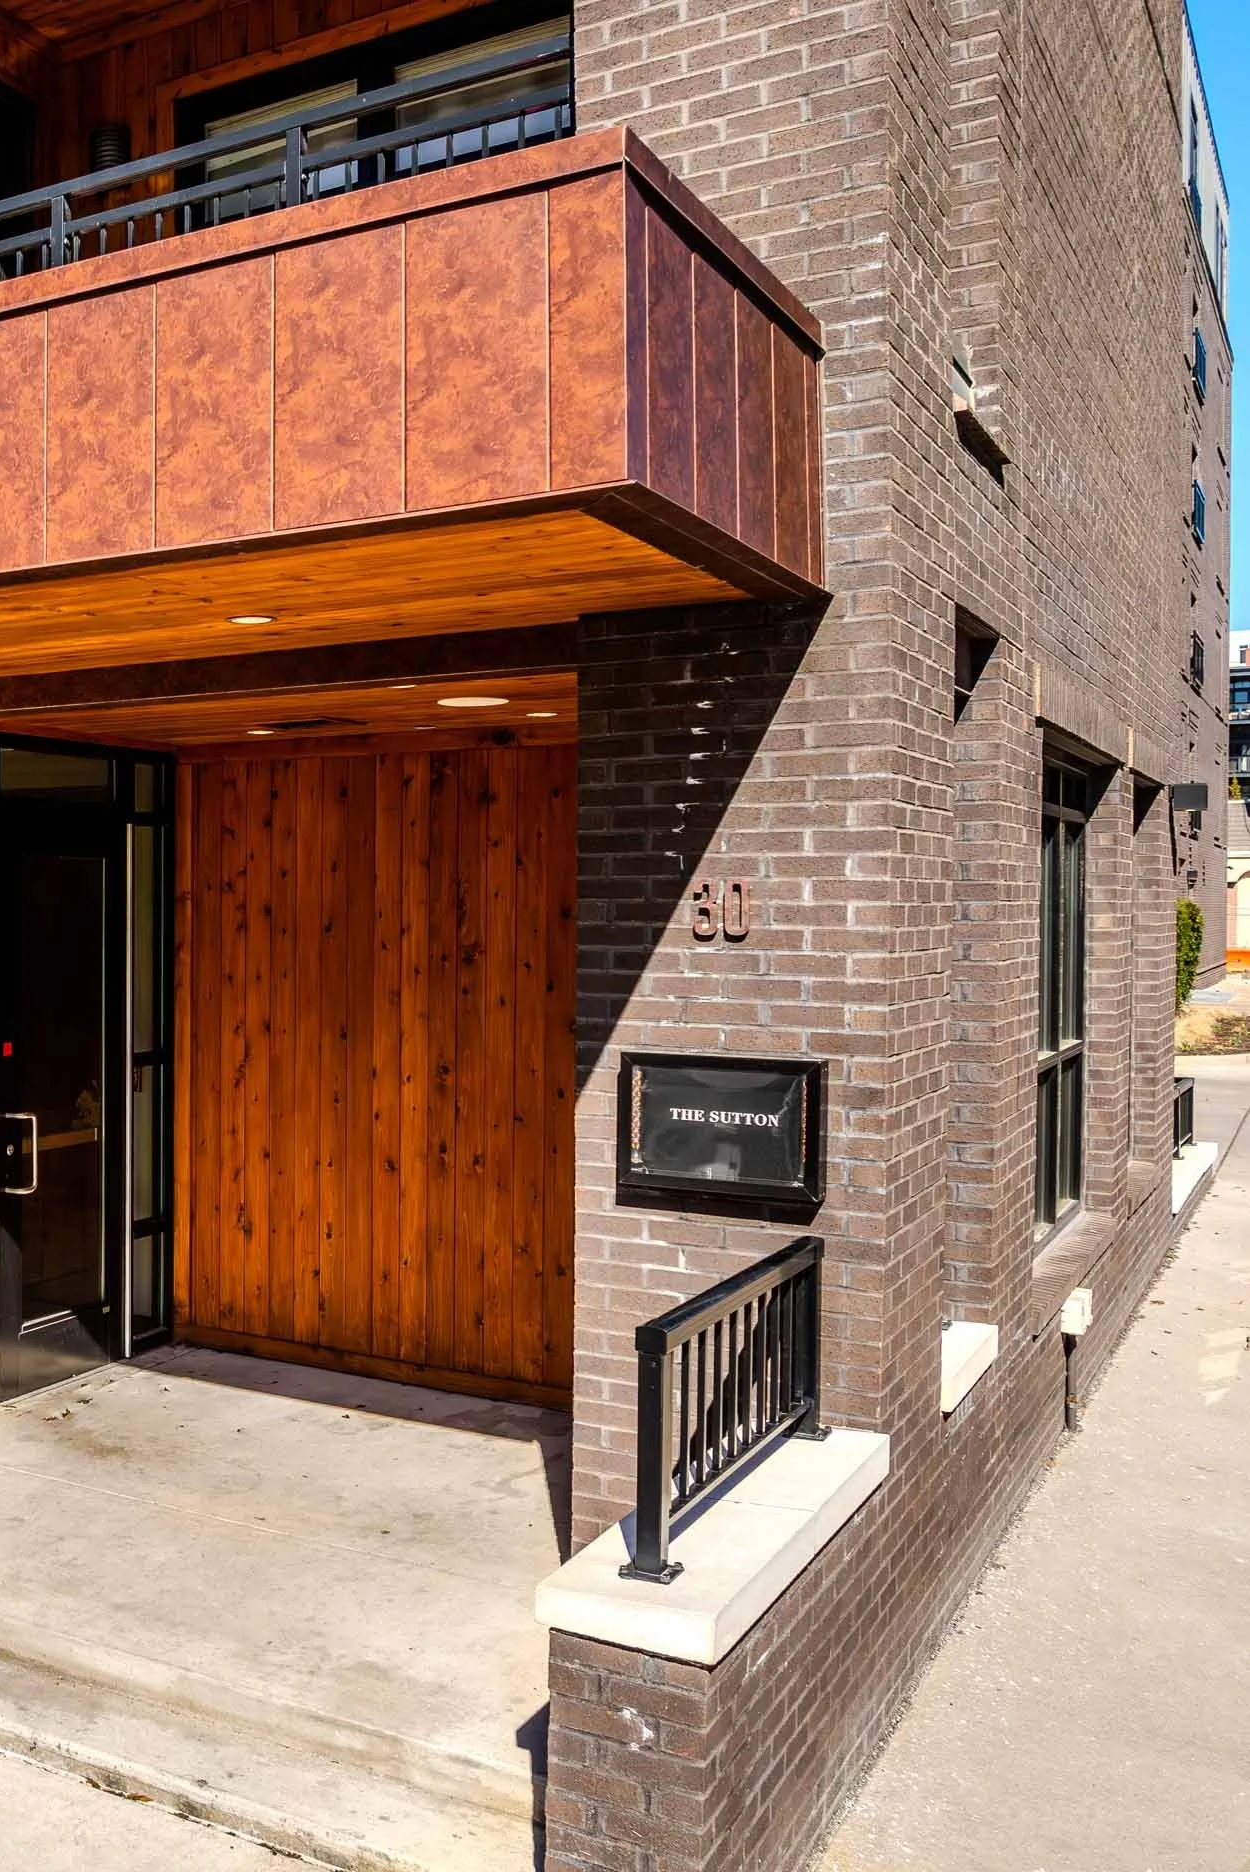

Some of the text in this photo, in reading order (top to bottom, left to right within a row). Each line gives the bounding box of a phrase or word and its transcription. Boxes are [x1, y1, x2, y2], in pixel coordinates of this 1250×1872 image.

[693, 879, 750, 940] 30
[669, 1107, 780, 1127] THE SUTTON
